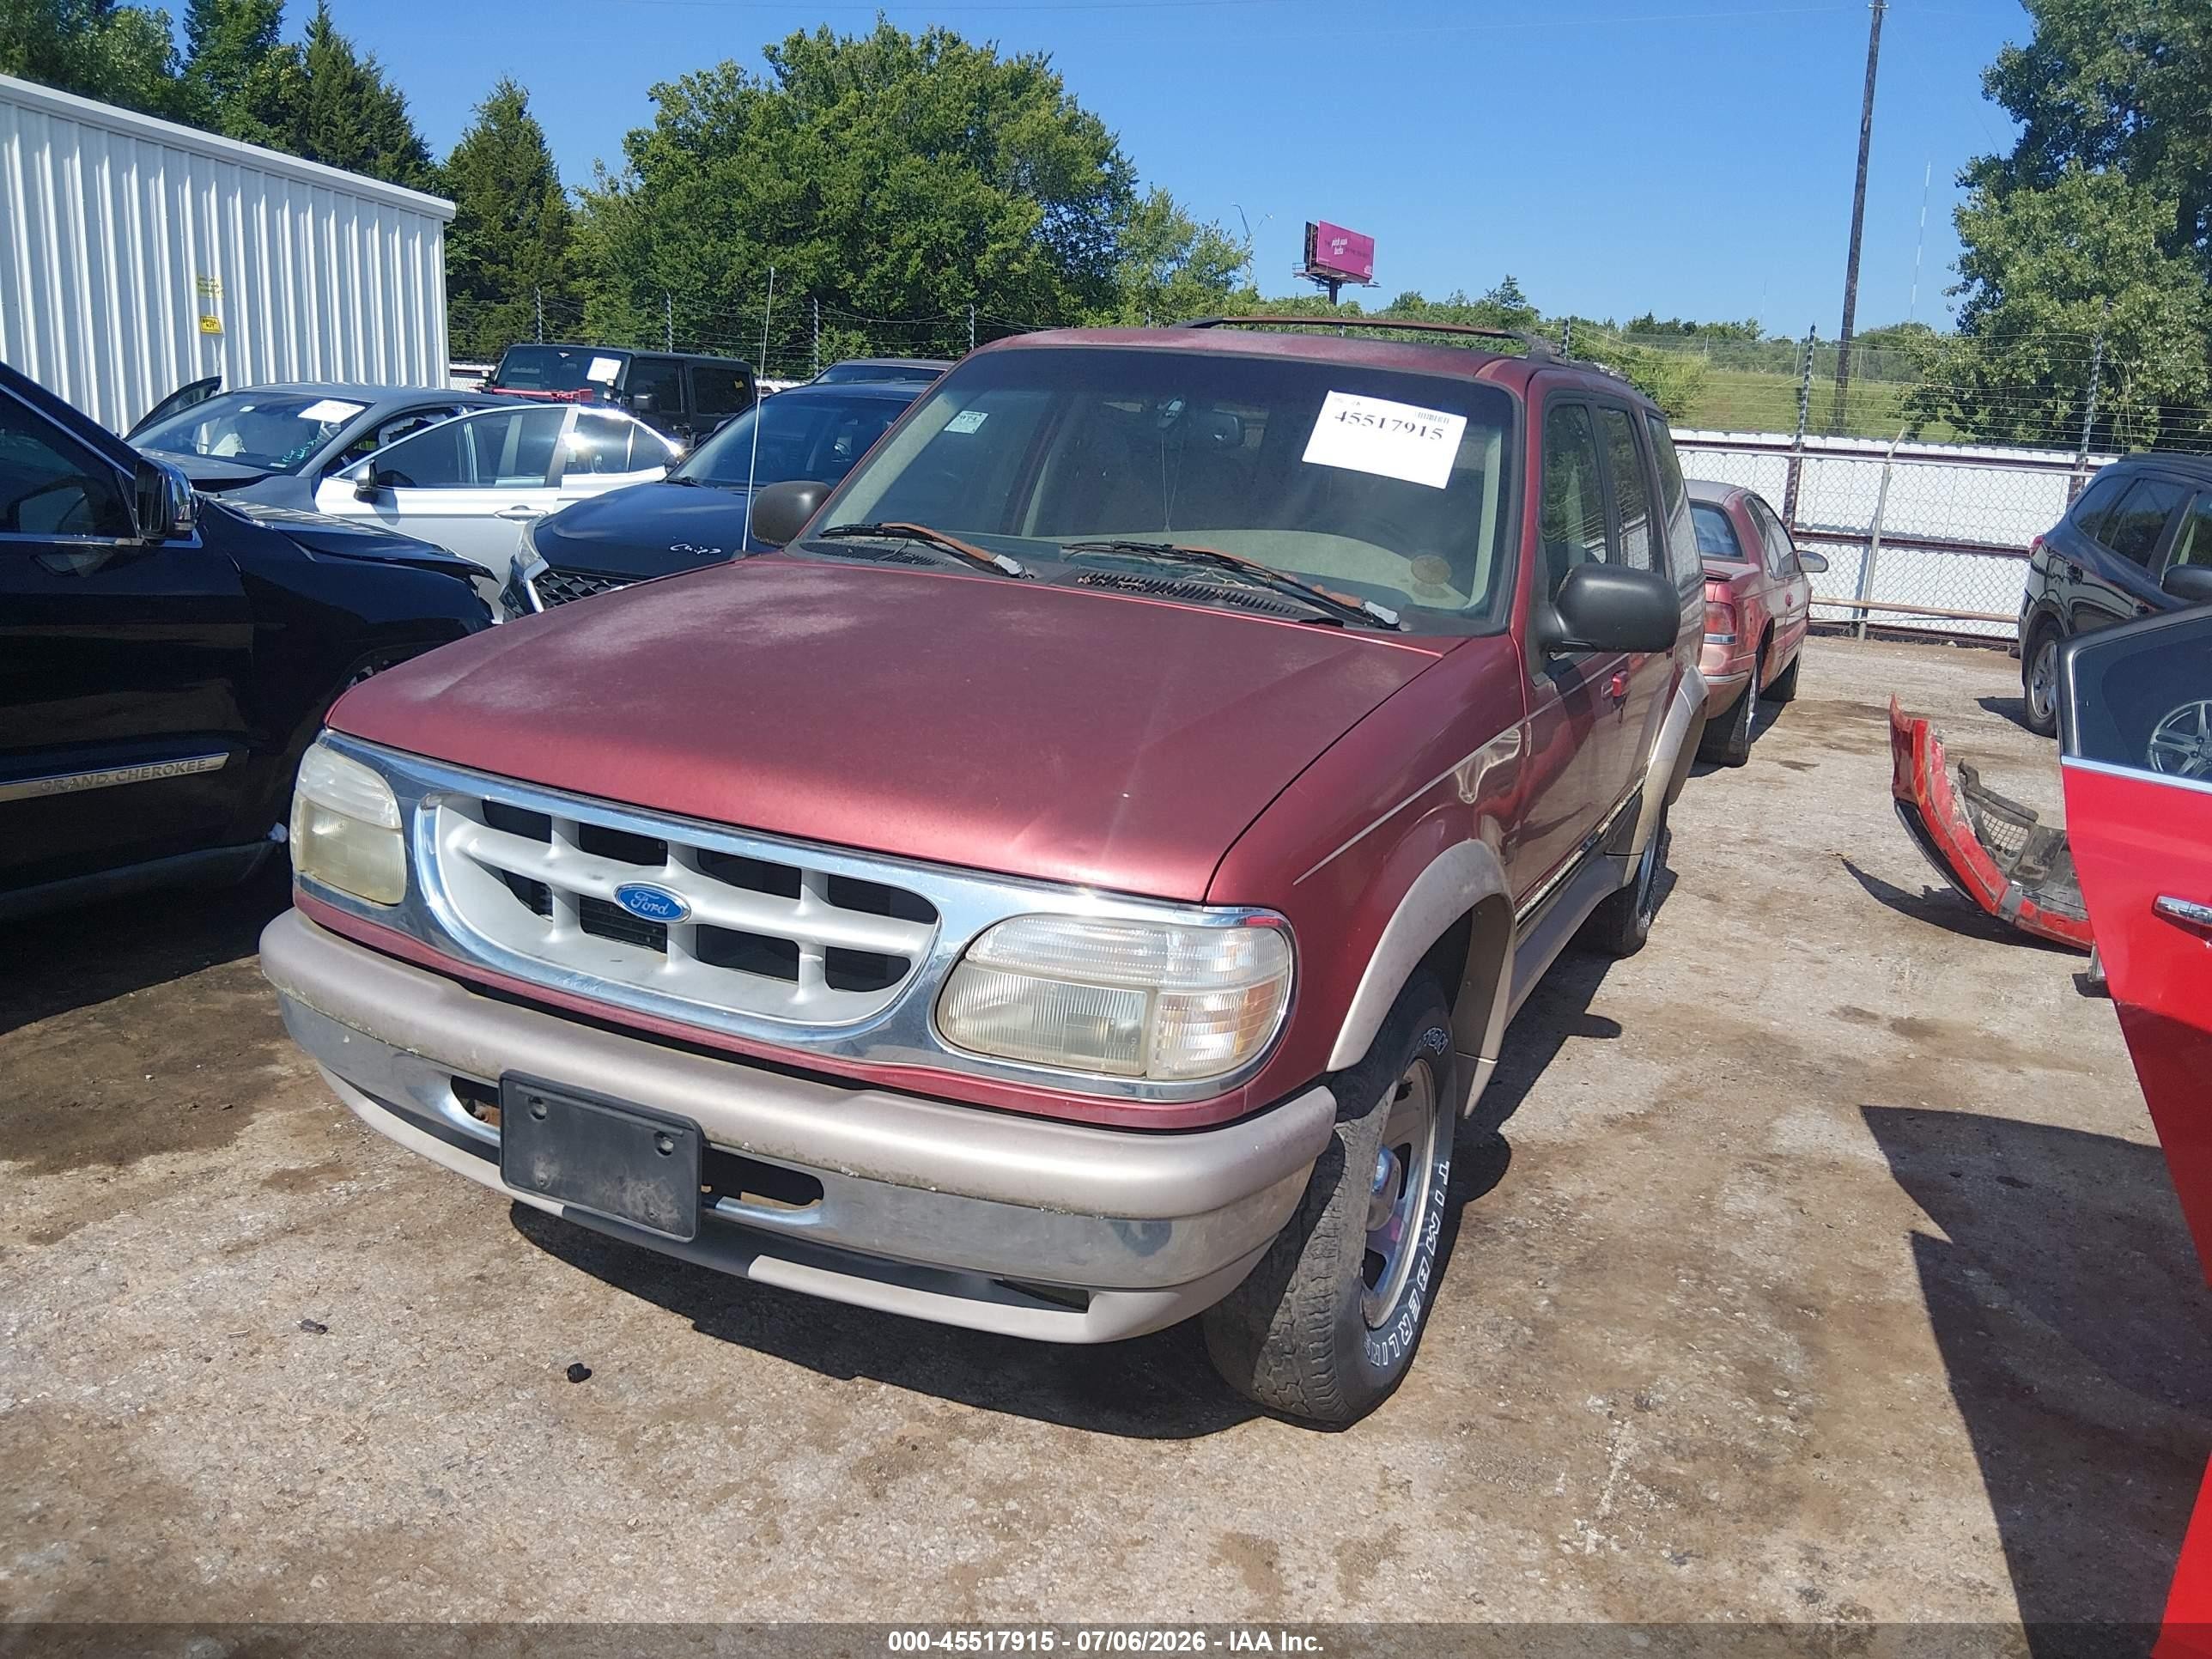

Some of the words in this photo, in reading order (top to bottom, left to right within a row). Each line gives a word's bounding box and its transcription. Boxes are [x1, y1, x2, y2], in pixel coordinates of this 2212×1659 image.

[1334, 410, 1443, 441] 45517915
[40, 773, 109, 792] GRAND
[115, 759, 206, 781] CHEROKEE
[629, 890, 671, 915] Ford
